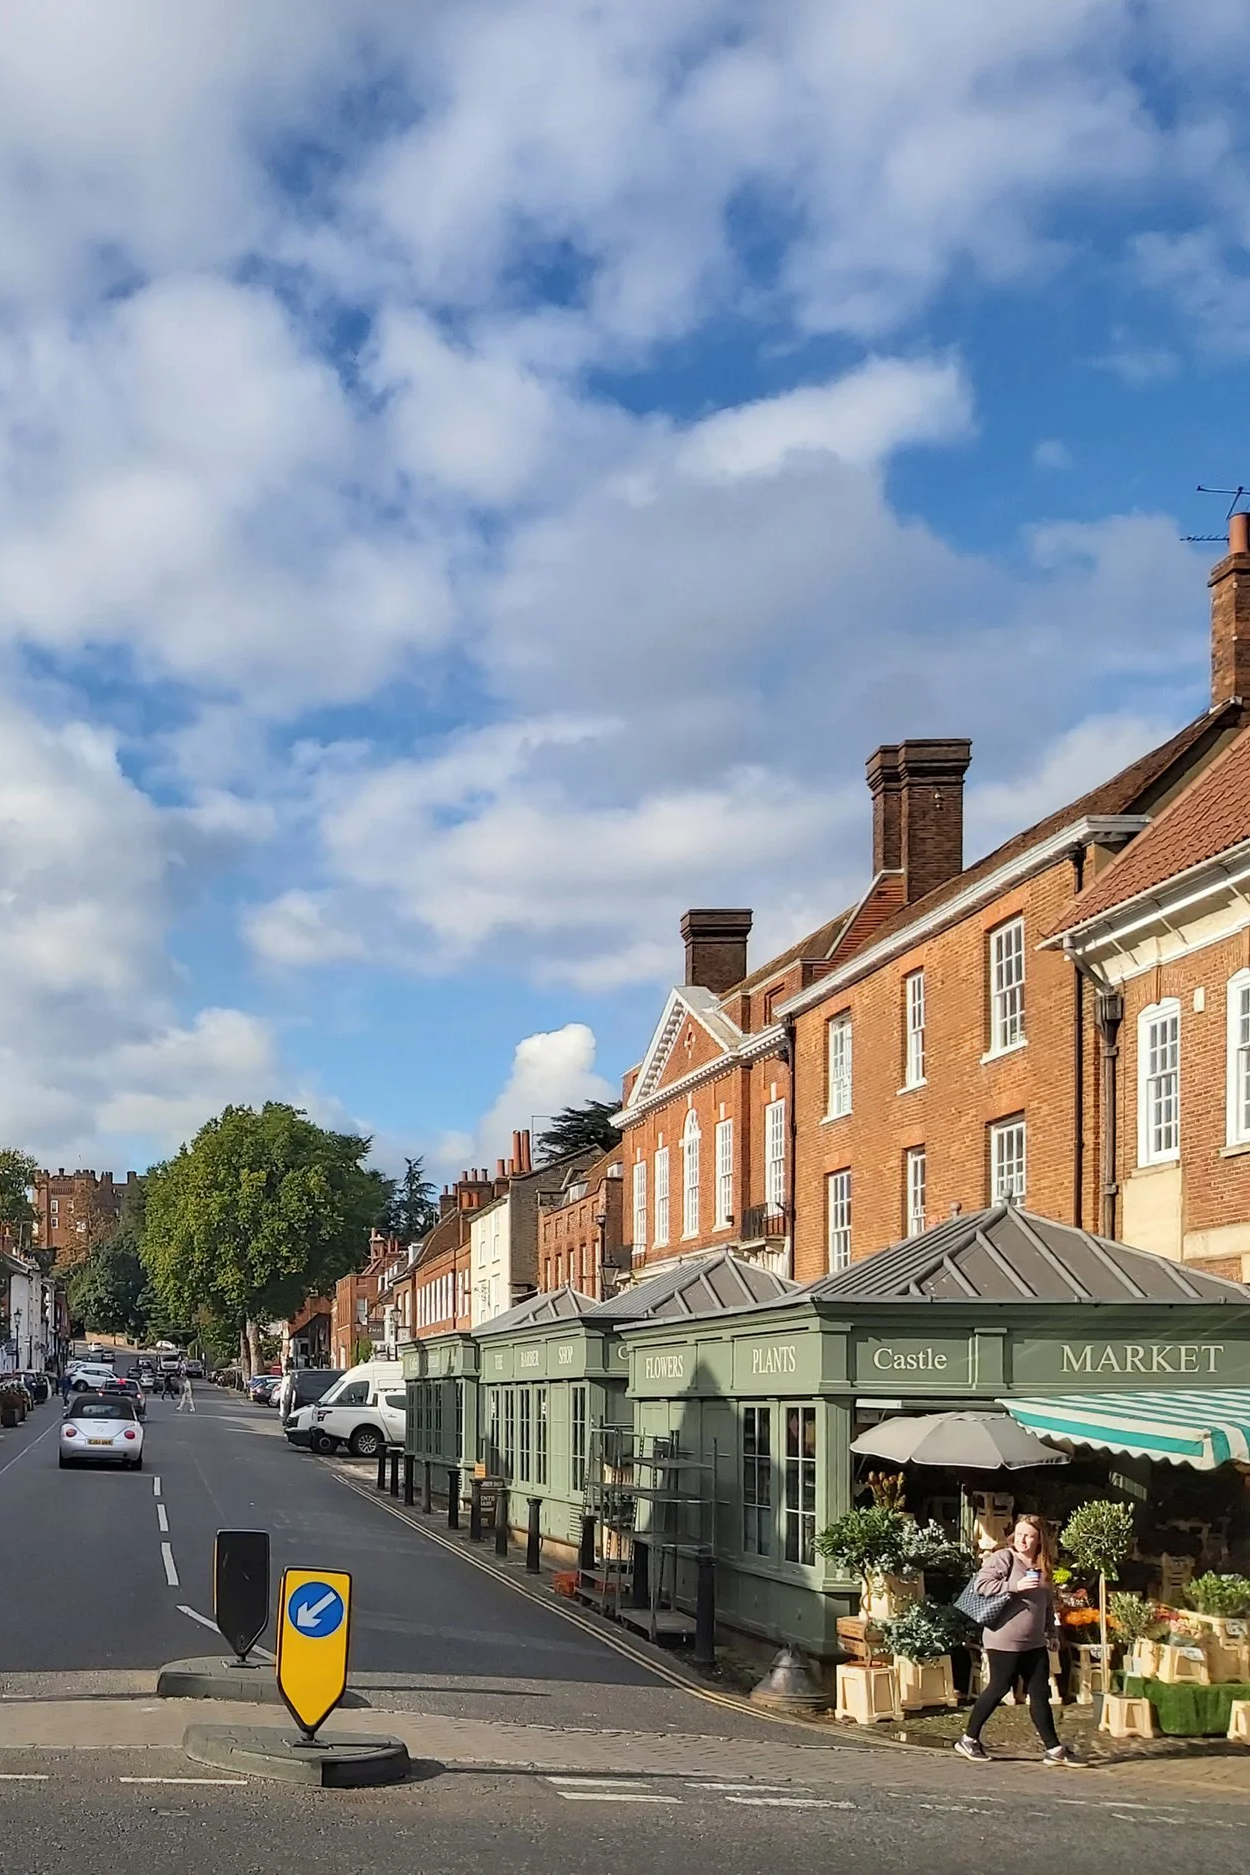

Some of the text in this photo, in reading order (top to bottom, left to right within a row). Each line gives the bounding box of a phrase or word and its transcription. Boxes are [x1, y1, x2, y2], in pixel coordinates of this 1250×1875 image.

[494, 1345, 574, 1370] THE BARBER SHOP
[645, 1345, 797, 1379] FLOWERS PLANTS
[873, 1344, 1225, 1374] Castle MARKET
